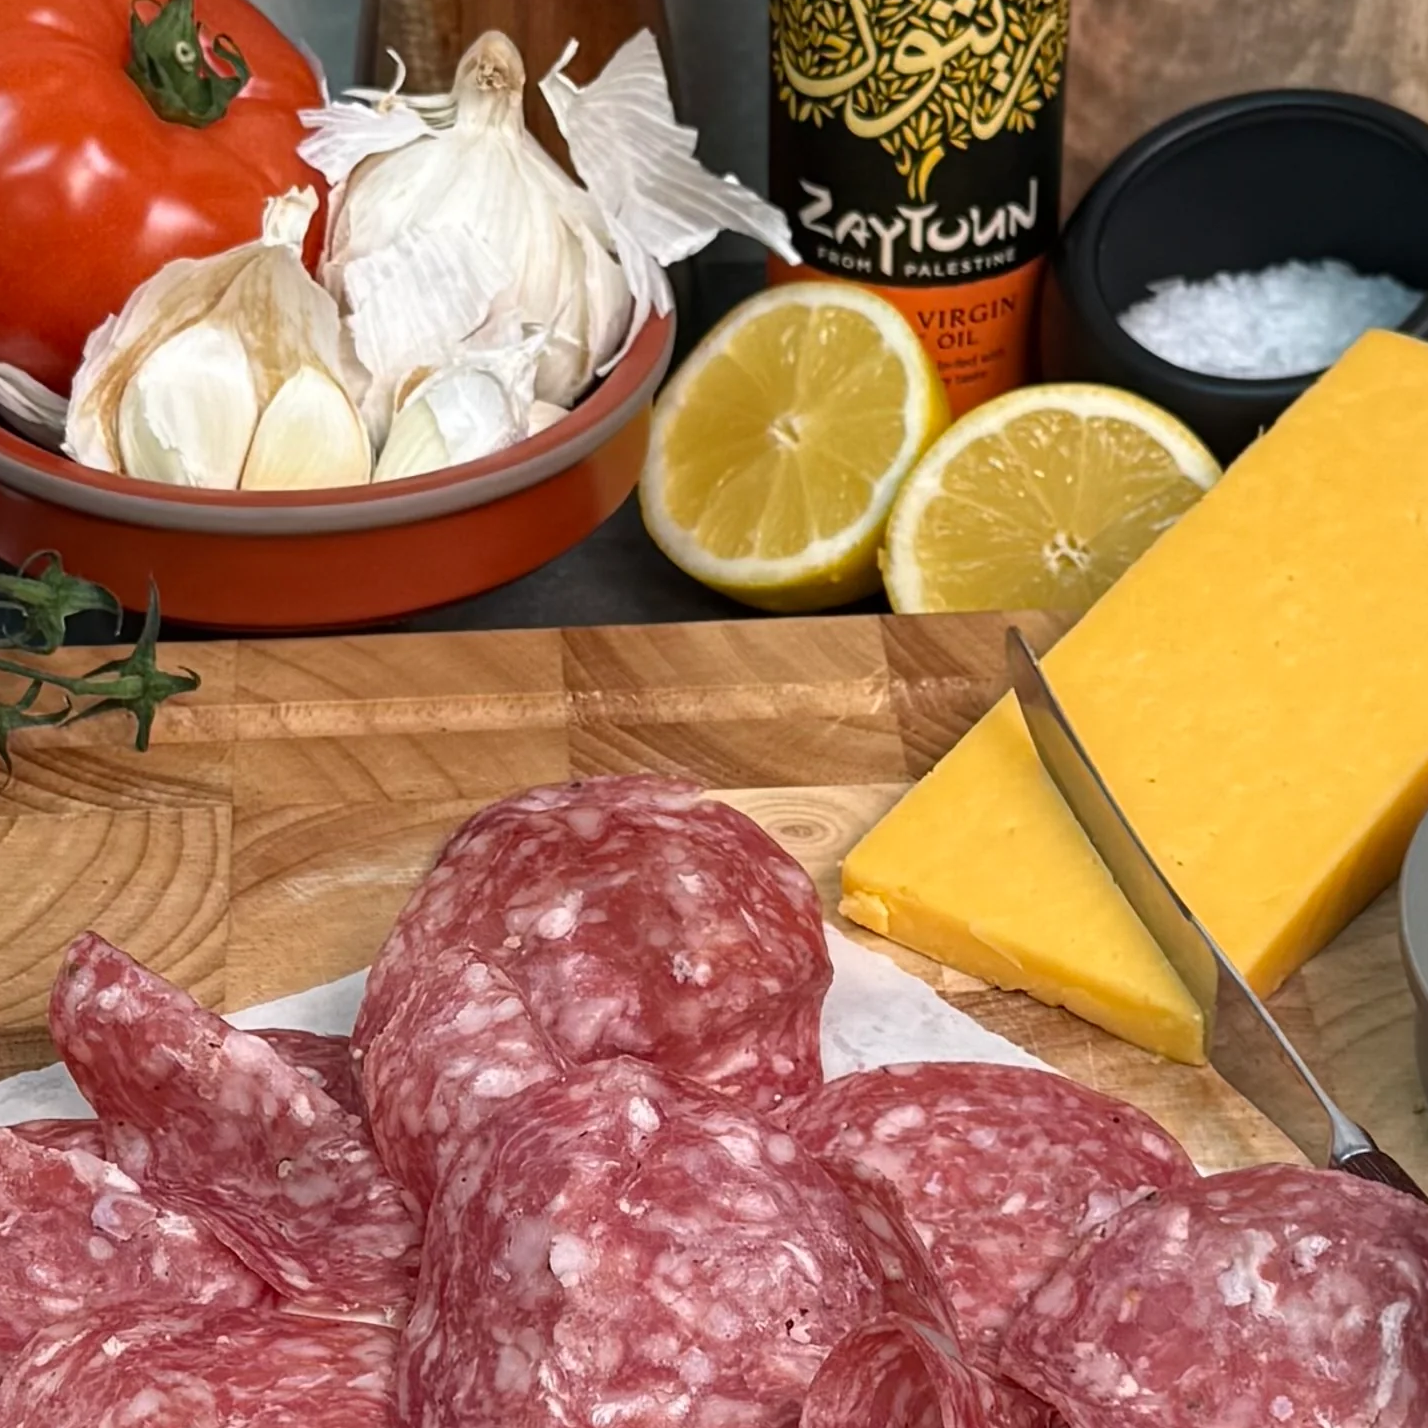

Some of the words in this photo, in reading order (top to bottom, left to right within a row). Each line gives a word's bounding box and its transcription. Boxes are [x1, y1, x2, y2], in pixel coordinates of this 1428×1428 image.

[798, 175, 1038, 276] ZAYTOUN
[816, 245, 872, 274] FROM
[903, 246, 1017, 278] PALESTINE
[917, 294, 1016, 329] VIRGIN
[936, 329, 979, 349] OIL
